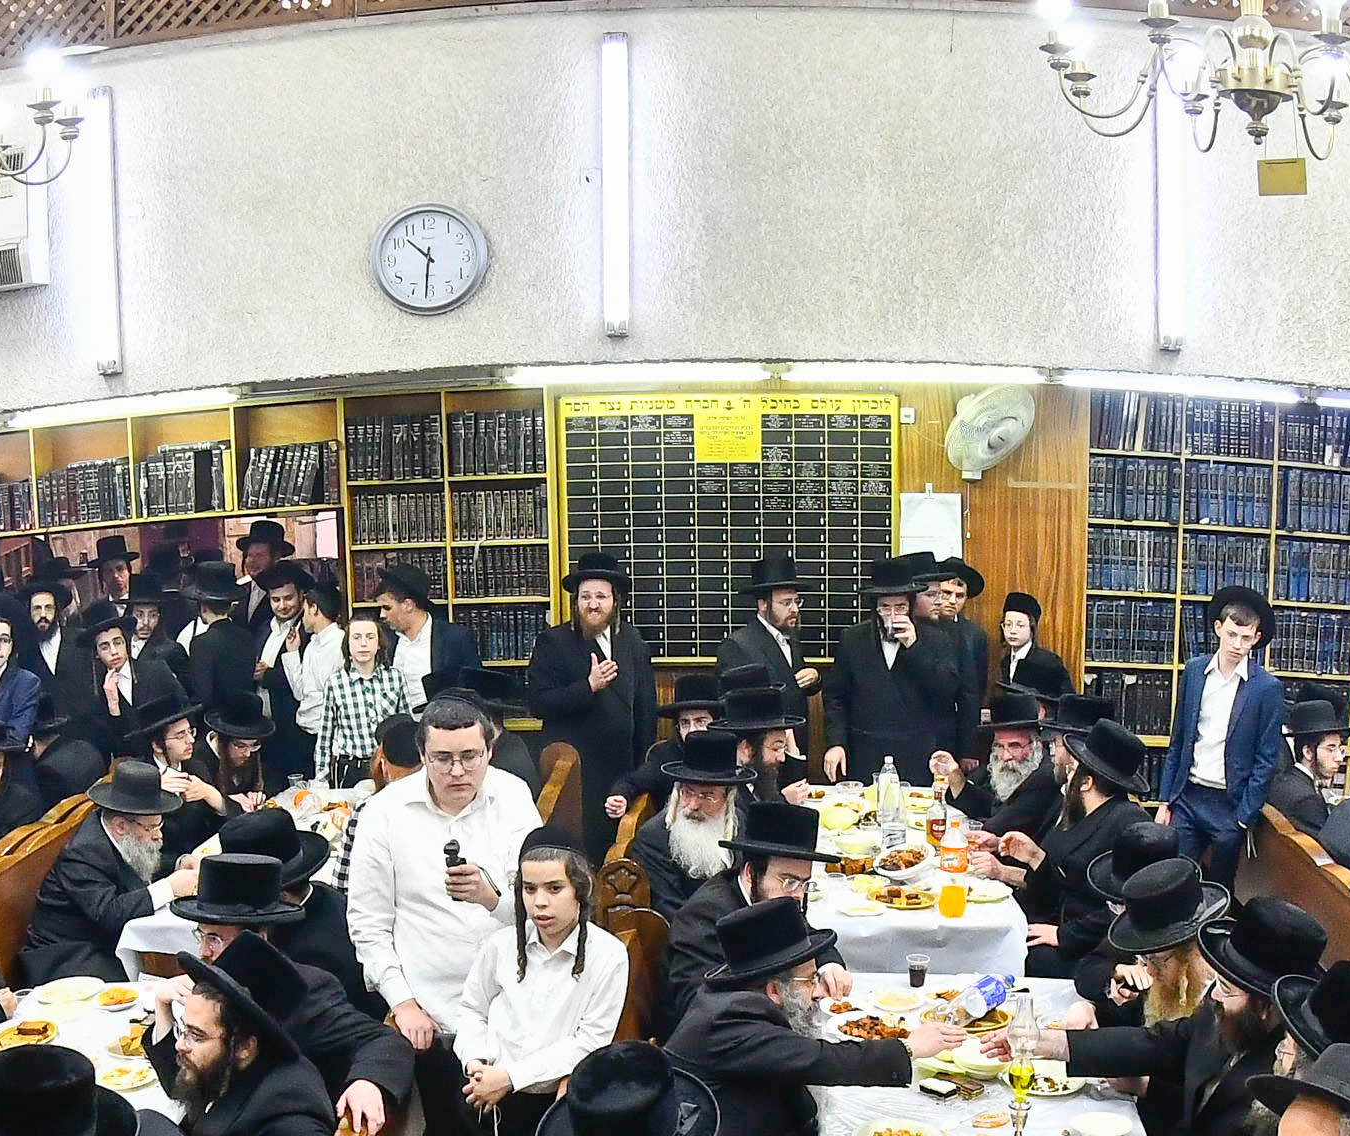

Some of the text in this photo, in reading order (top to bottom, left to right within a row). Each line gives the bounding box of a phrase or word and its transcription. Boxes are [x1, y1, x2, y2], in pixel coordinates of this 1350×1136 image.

[405, 223, 415, 237] 11
[422, 217, 436, 230] 12
[393, 237, 405, 250] 10
[455, 232, 464, 245] 2
[387, 255, 397, 268] 9
[462, 248, 471, 263] 3
[409, 282, 418, 296] 7
[629, 399, 676, 410] משניות
[685, 399, 719, 409] חברה
[760, 396, 801, 410] בהיכל
[810, 397, 842, 411] עולם
[852, 397, 892, 412] לזכרון
